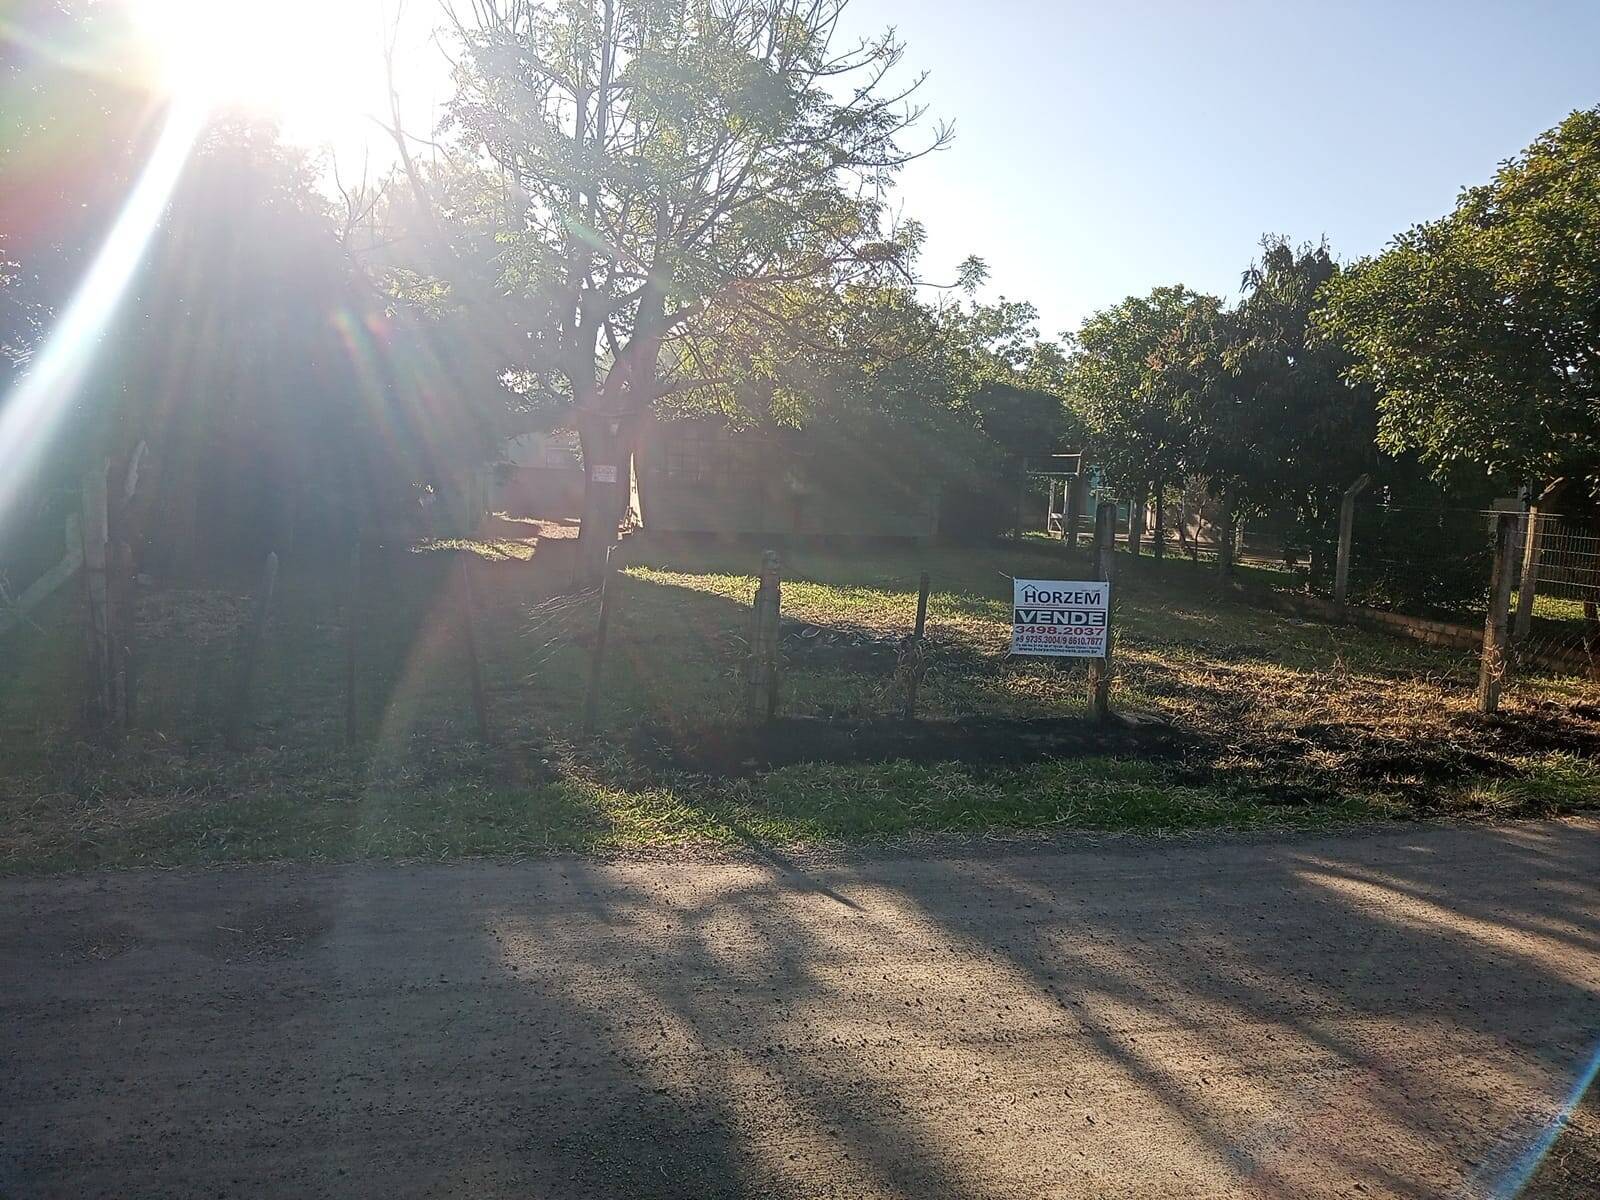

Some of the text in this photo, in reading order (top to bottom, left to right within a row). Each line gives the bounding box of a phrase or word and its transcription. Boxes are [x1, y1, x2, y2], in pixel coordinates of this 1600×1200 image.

[1024, 591, 1101, 605] HORZEM
[1018, 610, 1104, 625] VENDE
[1015, 625, 1105, 635] 3498.2037
